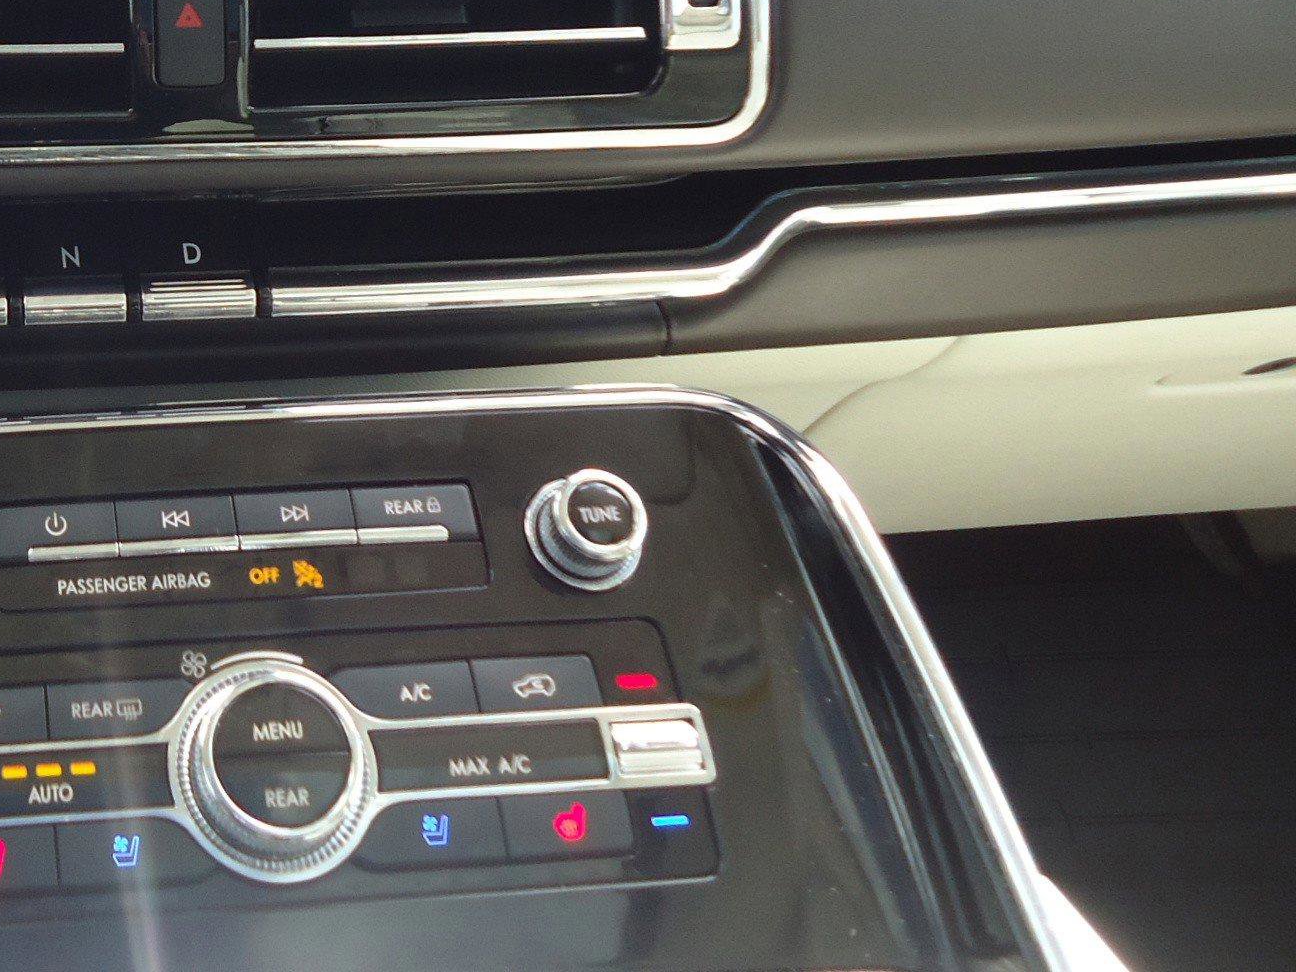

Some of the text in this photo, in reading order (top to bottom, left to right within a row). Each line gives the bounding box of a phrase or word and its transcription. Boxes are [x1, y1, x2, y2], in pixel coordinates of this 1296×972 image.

[61, 245, 81, 269] N
[182, 242, 202, 266] D
[384, 499, 423, 516] REAR
[579, 506, 622, 524] TUNE
[57, 571, 212, 596] PASSENGER AIRBAG
[249, 566, 281, 585] OFF
[400, 683, 432, 703] A/C
[71, 701, 113, 720] REAR
[252, 720, 304, 742] MENU
[449, 755, 532, 777] MAX A/C
[28, 784, 74, 805] AUTO
[264, 788, 310, 808] REAR
